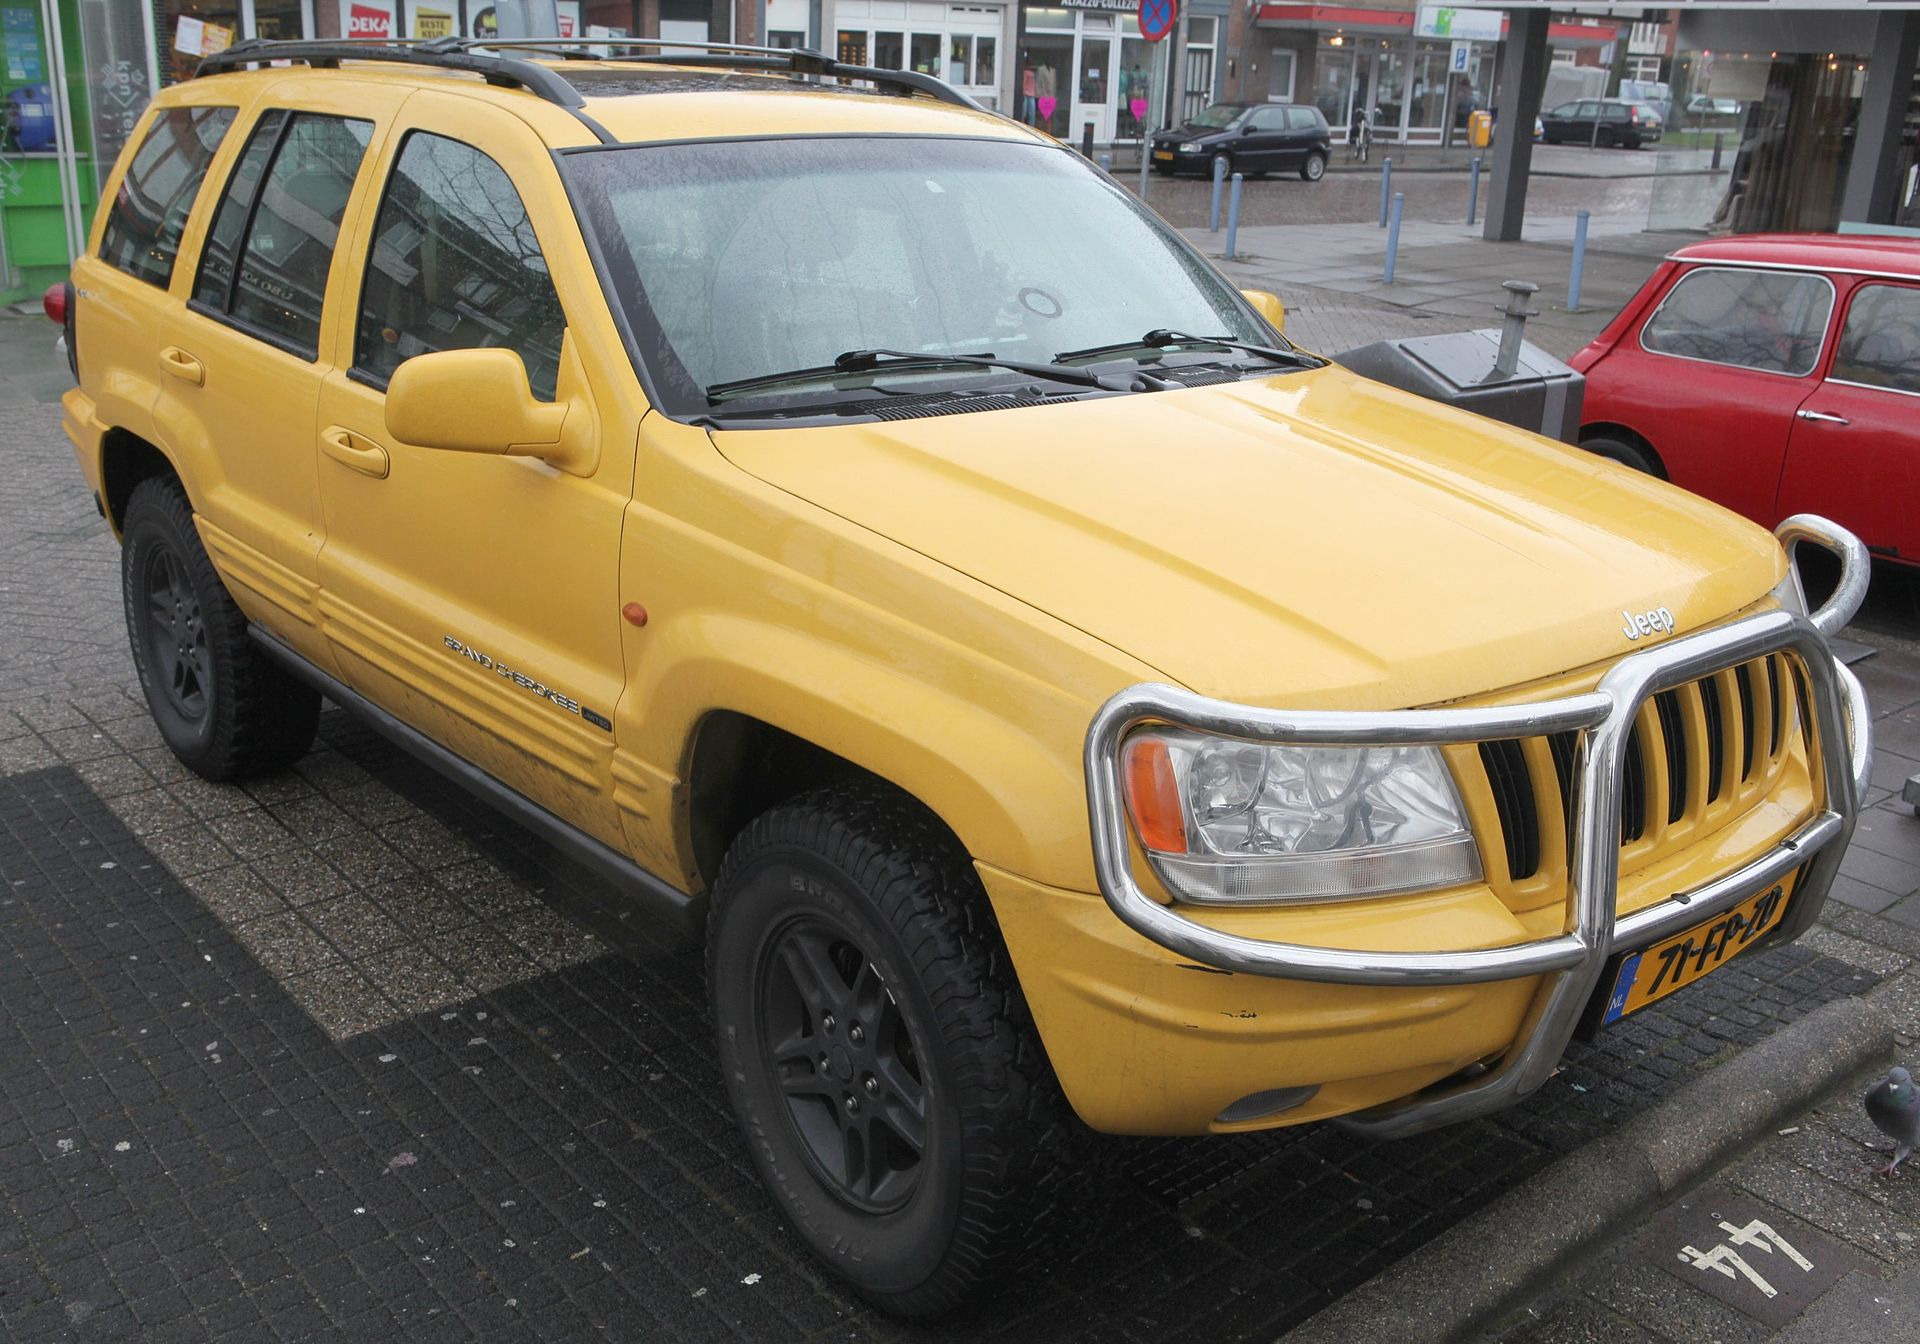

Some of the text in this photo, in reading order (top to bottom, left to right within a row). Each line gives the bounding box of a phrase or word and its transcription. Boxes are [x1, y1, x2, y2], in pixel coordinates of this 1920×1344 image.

[350, 17, 390, 32] DEKA
[420, 20, 445, 29] BESTE
[113, 60, 131, 96] kpn
[1622, 606, 1674, 640] Jeep
[443, 634, 579, 715] GRAND CHEROKEE
[583, 708, 610, 730] LIMITED
[1647, 885, 1783, 996] 71-FP-ZD
[1609, 994, 1623, 1012] NL
[1681, 1219, 1814, 1298] 44
